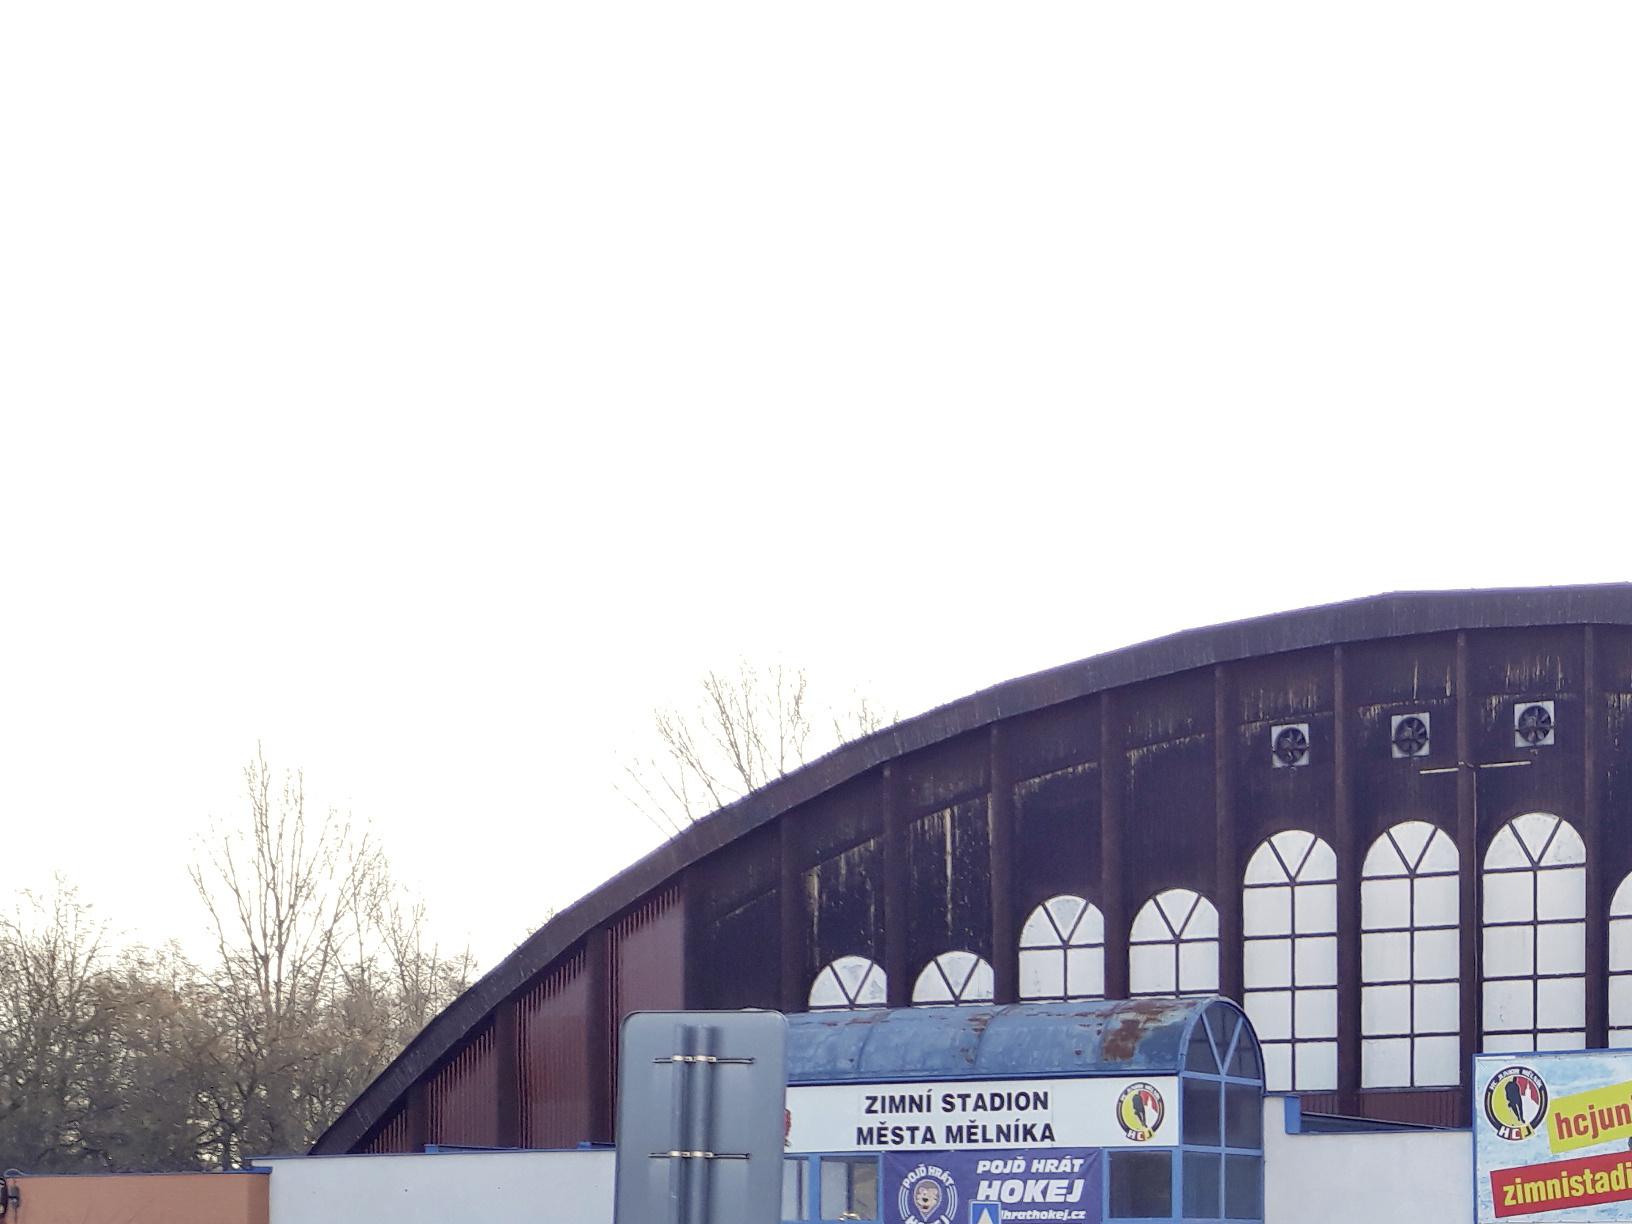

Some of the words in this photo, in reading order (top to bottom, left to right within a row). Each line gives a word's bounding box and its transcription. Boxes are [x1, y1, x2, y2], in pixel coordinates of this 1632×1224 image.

[864, 1090, 933, 1115] ZIMNÍ
[941, 1090, 1050, 1113] STADION
[856, 1121, 936, 1146] MĚSTA
[945, 1119, 1056, 1144] MĚLNÍKA
[902, 1163, 927, 1188] POJĎ
[928, 1165, 955, 1187] HRÁT
[976, 1155, 1026, 1174] POJĎ
[1030, 1155, 1084, 1173] HRÁT
[976, 1179, 1085, 1204] HOKEJ
[1001, 1209, 1086, 1221] hrathokej.cz
